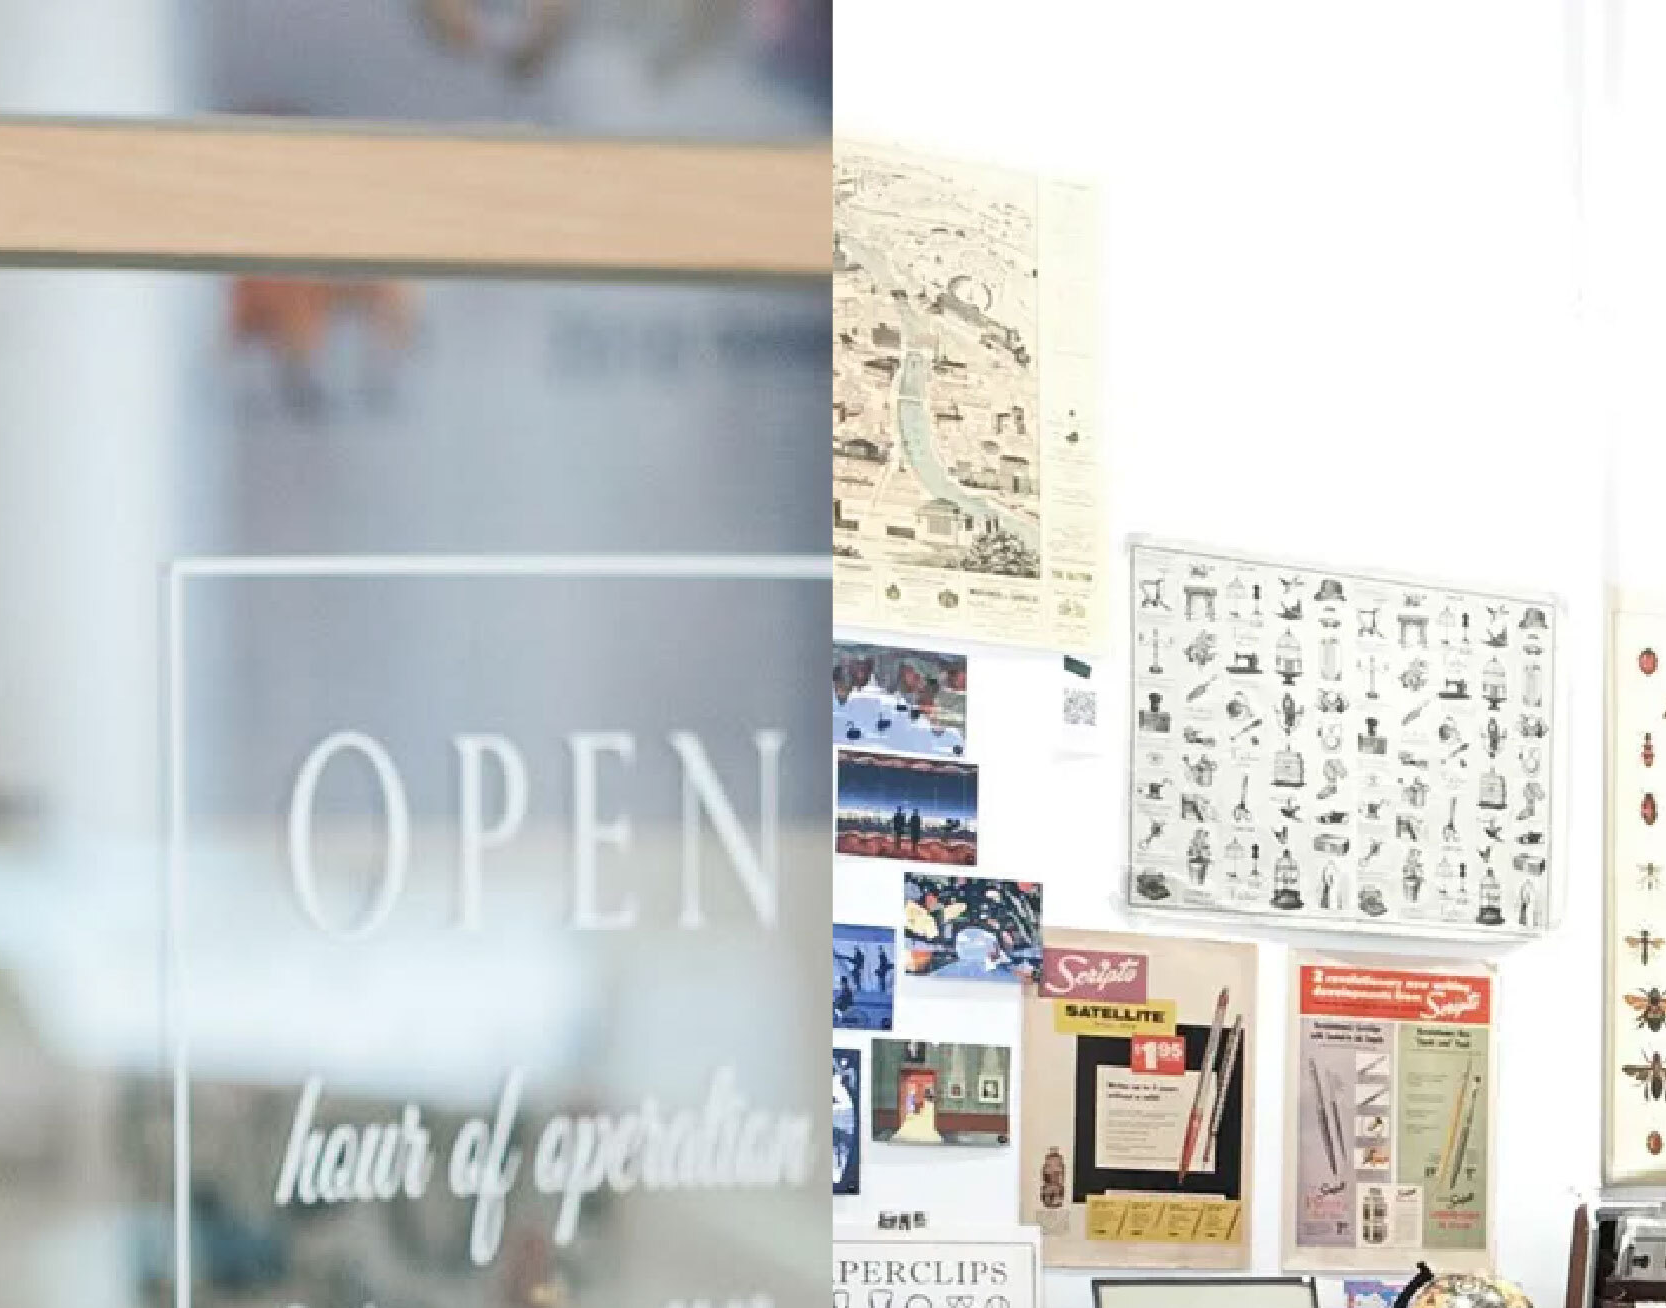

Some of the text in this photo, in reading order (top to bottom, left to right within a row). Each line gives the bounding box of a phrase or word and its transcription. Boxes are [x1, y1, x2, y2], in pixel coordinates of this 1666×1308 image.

[287, 730, 787, 941] OPEN
[1065, 1004, 1166, 1024] SATELLITE
[275, 1064, 814, 1266] hour of operation
[833, 1260, 1008, 1286] PERCLIPS
